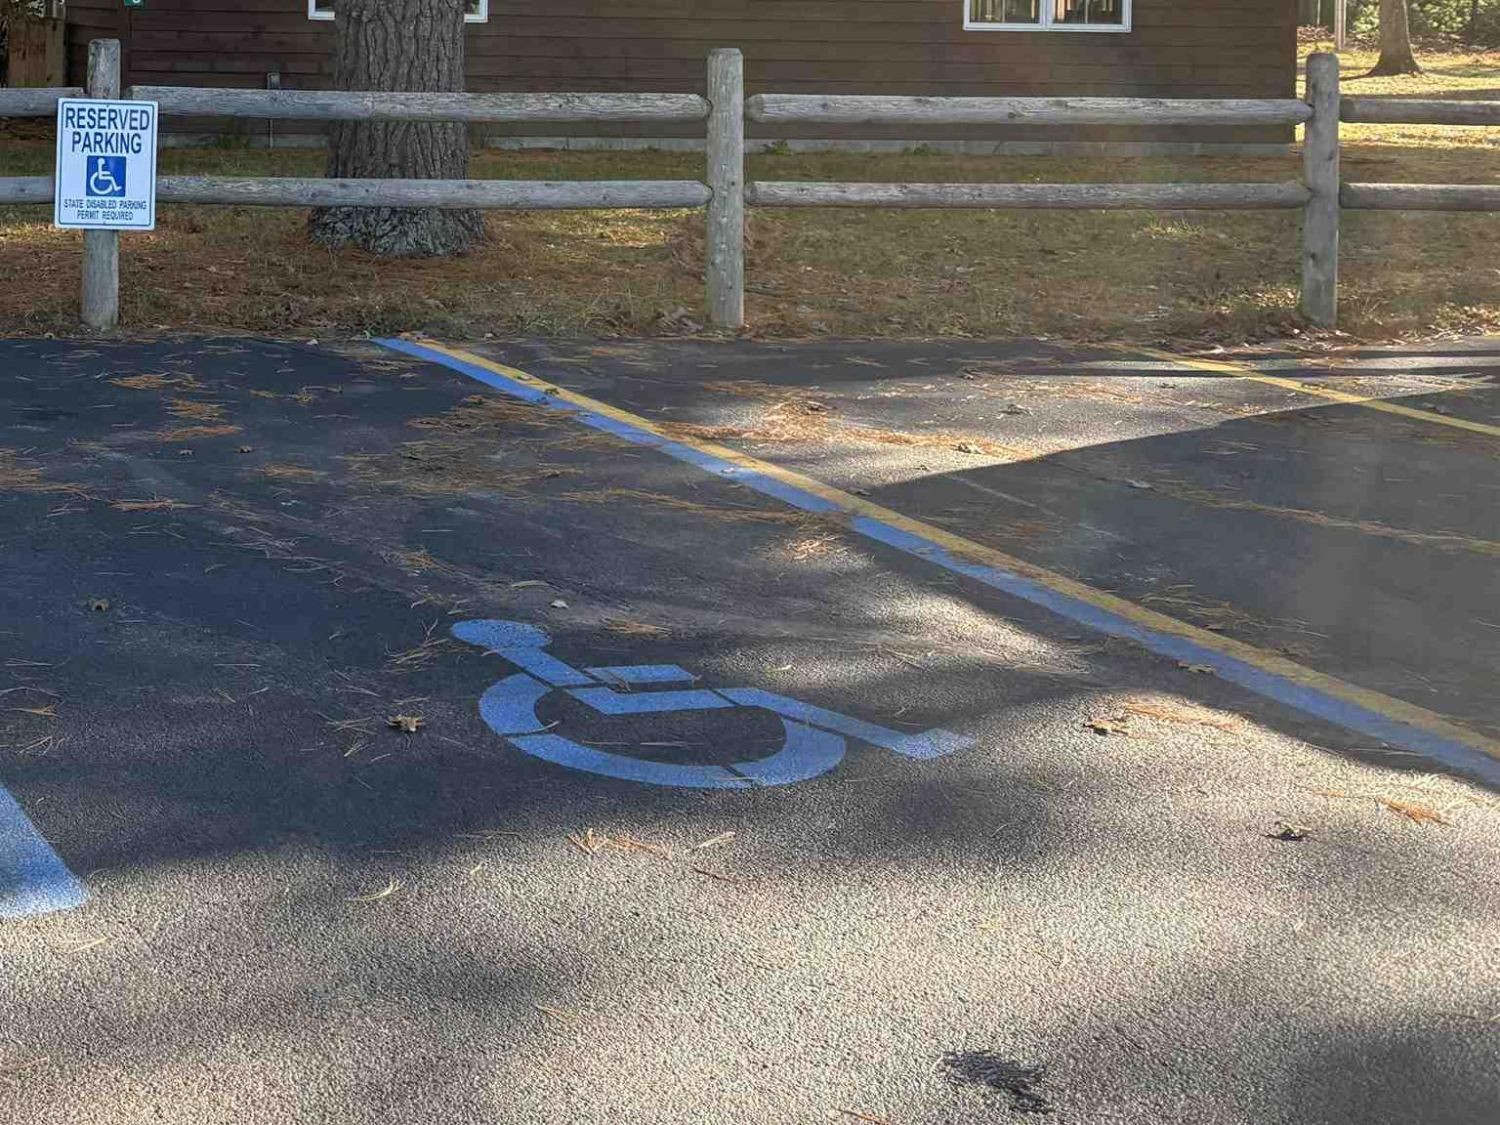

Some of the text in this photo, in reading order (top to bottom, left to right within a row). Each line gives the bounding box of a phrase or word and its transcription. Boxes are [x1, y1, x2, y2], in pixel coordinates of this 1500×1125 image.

[65, 107, 150, 131] RESERVED
[71, 131, 142, 154] PARKING
[63, 198, 148, 210] STATE DISABLED PARKING
[77, 210, 134, 221] PERMIT REQUIRED
